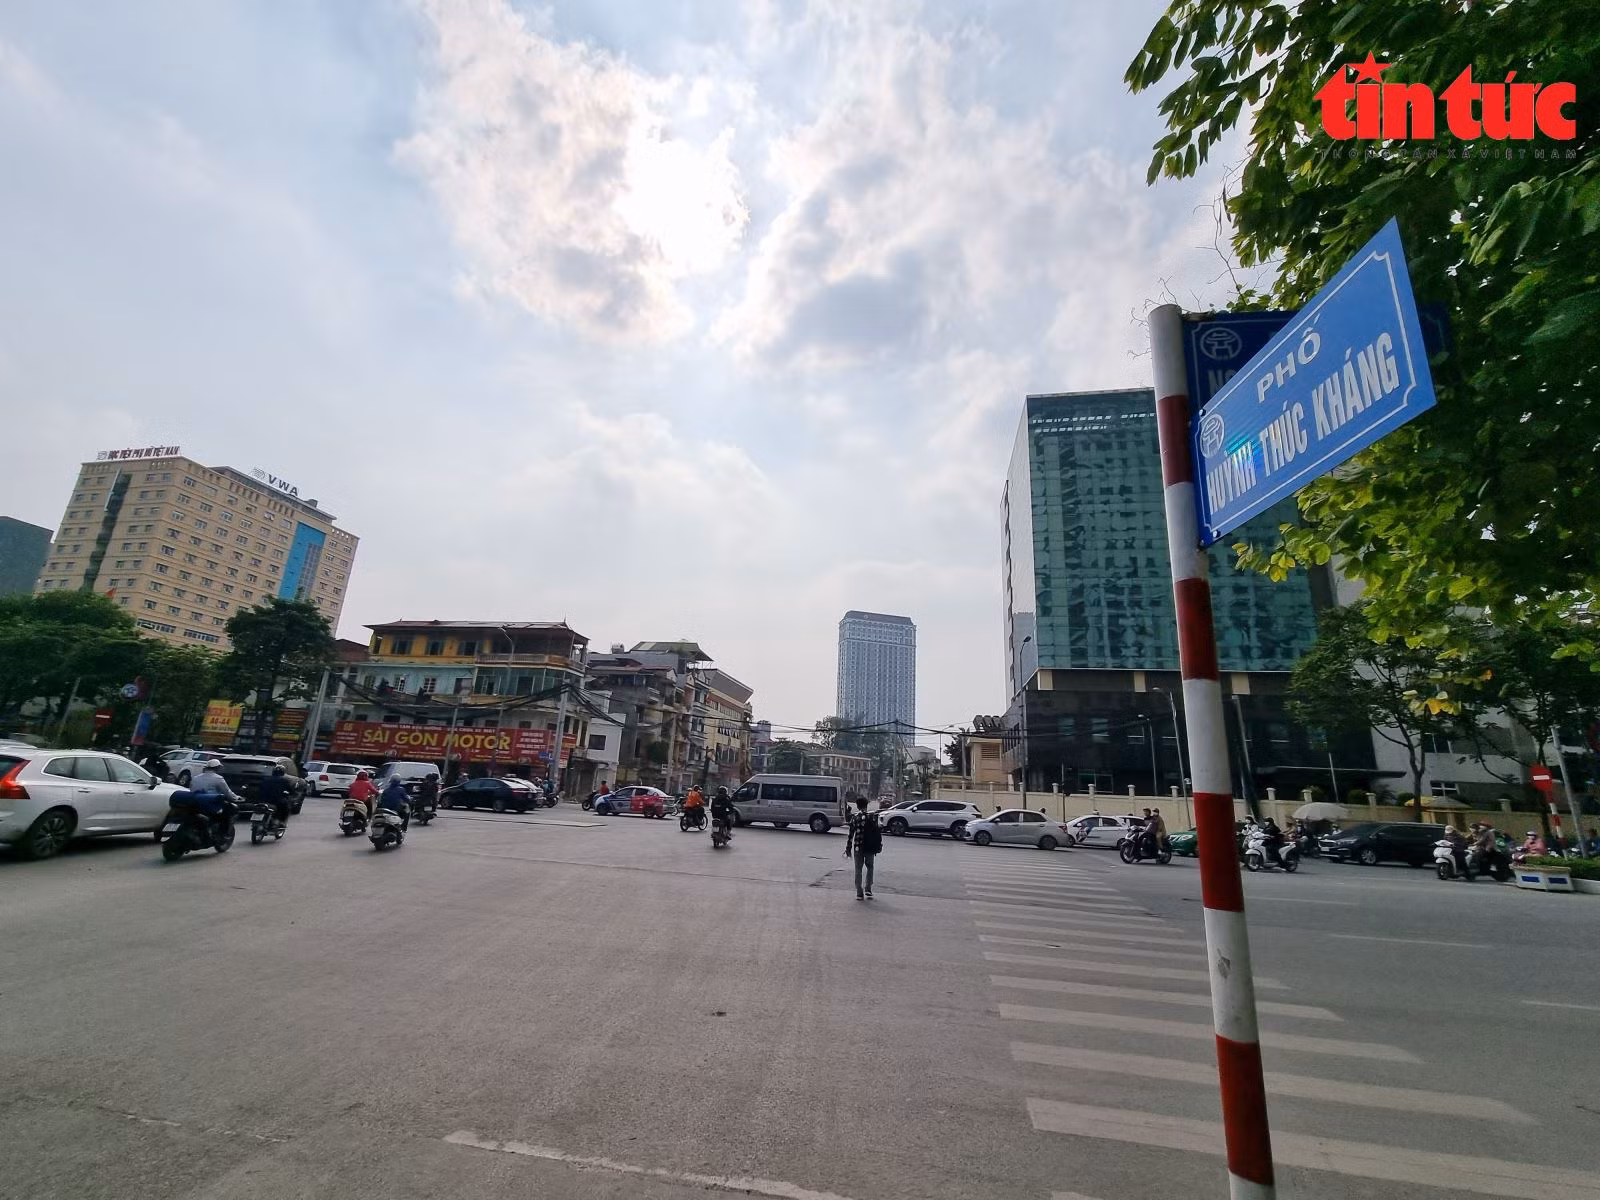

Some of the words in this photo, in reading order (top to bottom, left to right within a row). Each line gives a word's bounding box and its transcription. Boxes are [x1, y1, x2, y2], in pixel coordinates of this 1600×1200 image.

[1257, 313, 1320, 403] PHỐ
[1259, 400, 1308, 477] THÚC
[1311, 332, 1400, 441] KHÁNG
[268, 473, 298, 497] VWA
[362, 727, 390, 744] SÀI
[394, 729, 438, 747] GÒN
[442, 733, 511, 750] MOTOR
